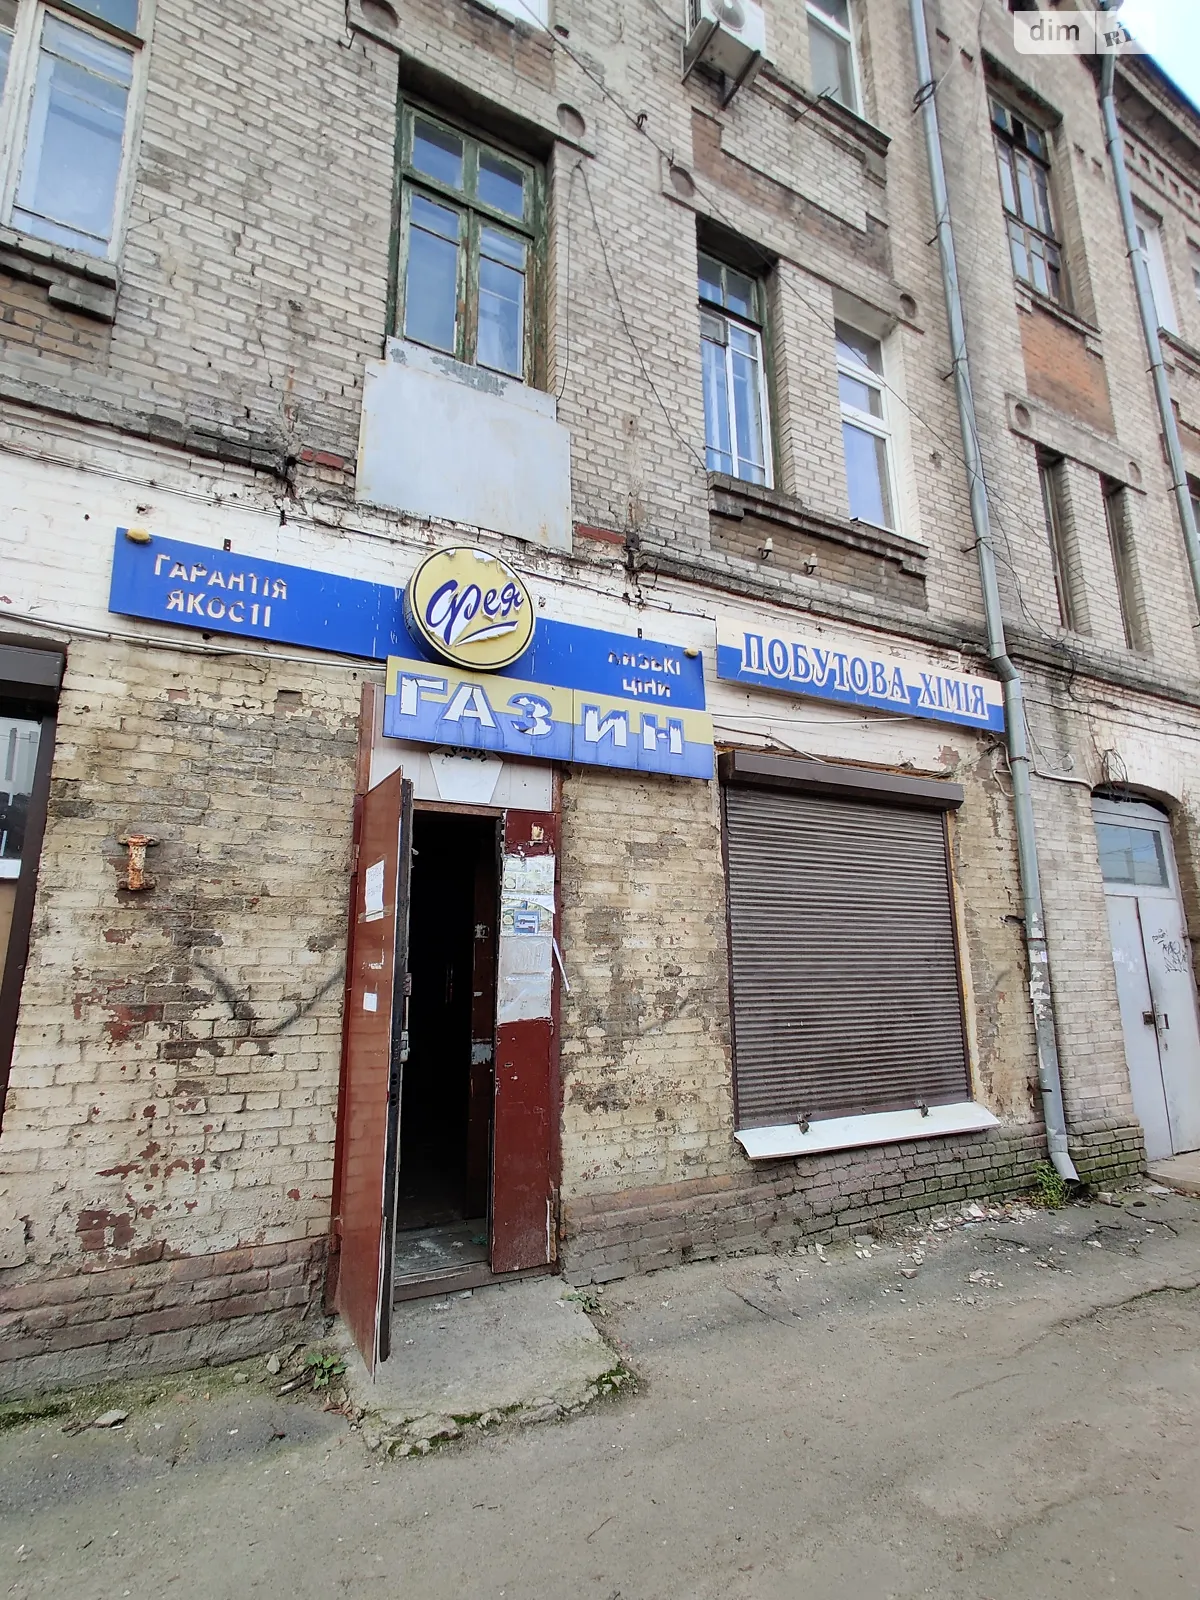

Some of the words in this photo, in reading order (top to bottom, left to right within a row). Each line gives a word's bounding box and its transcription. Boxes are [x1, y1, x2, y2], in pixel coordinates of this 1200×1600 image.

[425, 579, 525, 646] Фея
[743, 631, 910, 703] ПОБУТОВА
[917, 671, 987, 719] ХІМІЯ
